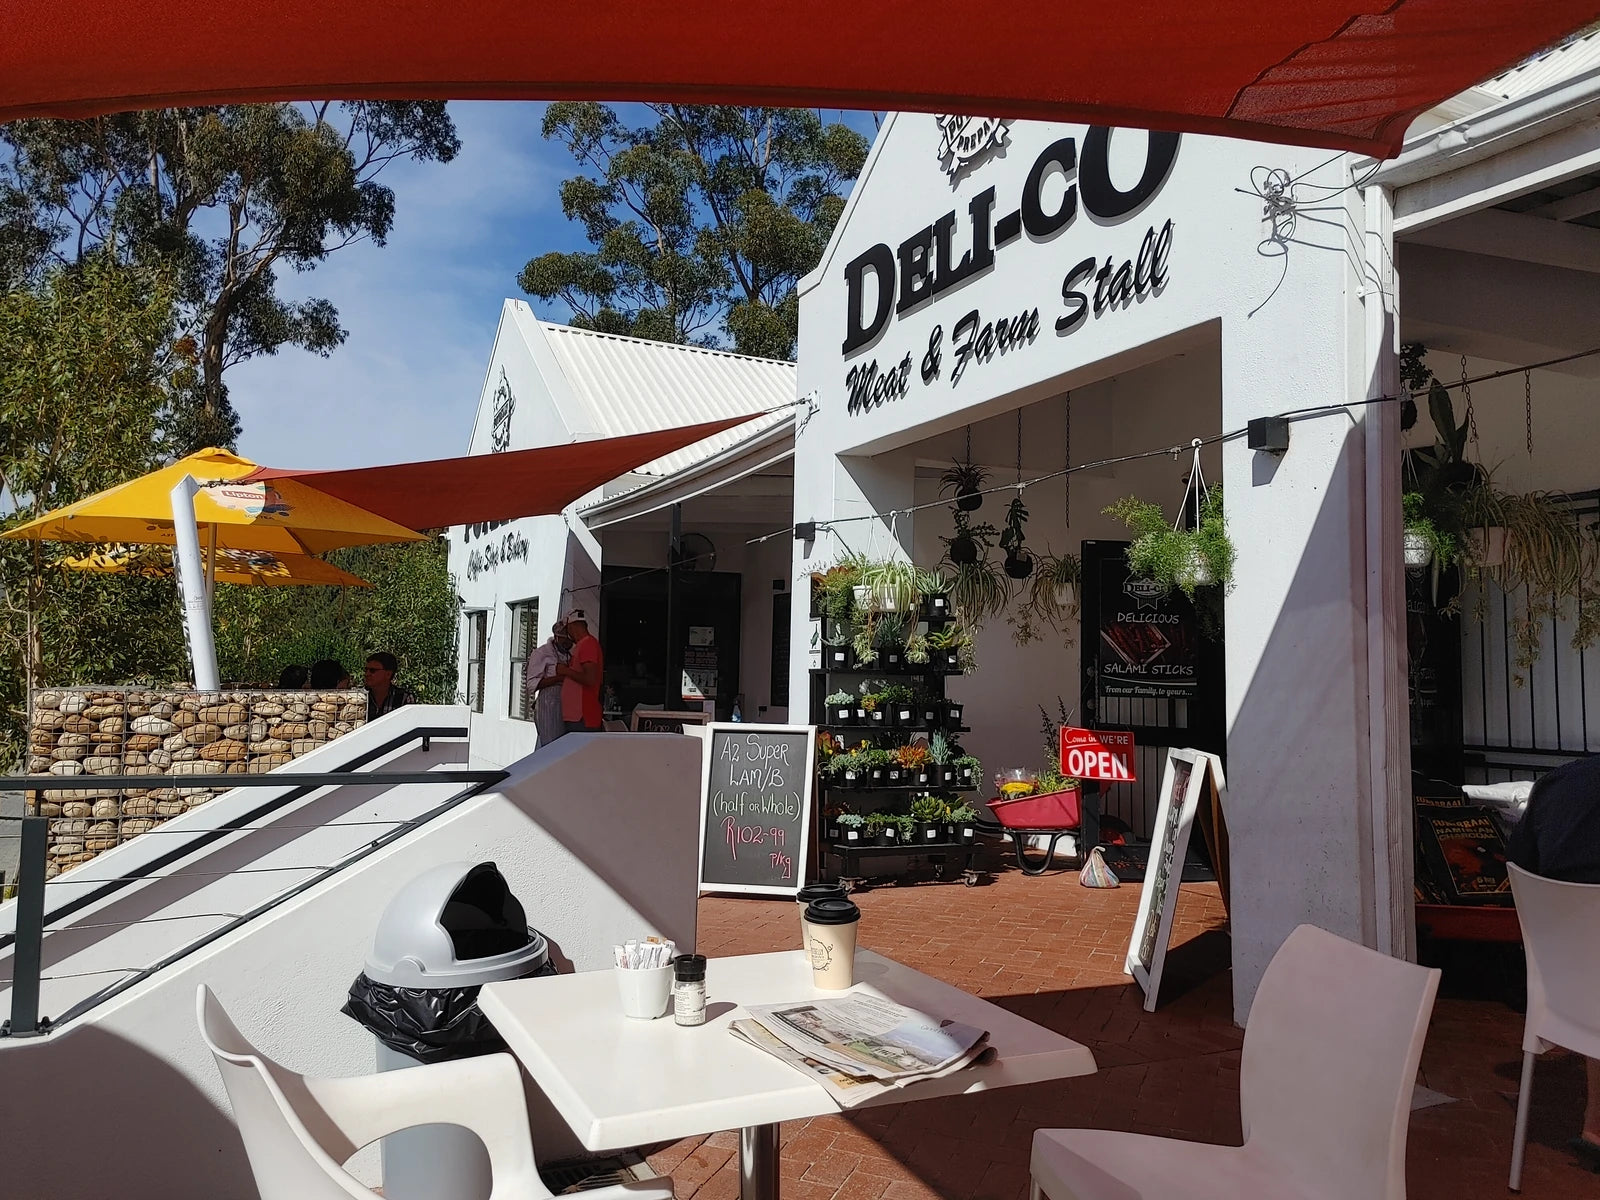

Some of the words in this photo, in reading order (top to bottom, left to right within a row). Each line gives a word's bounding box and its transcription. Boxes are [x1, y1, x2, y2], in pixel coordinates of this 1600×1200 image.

[957, 117, 994, 152] PREPA
[842, 124, 1181, 356] DELI-CO
[846, 351, 911, 413] Meat
[921, 325, 943, 381] &
[950, 306, 1039, 383] Farm
[1055, 218, 1172, 331] Stall
[225, 491, 263, 500] Lipton
[1117, 612, 1180, 625] DELICIOUS
[1103, 662, 1148, 675] SALAMI
[1151, 664, 1194, 676] STICKS
[1105, 685, 1122, 694] From
[720, 736, 740, 762] A2
[1064, 729, 1087, 744] Come
[1088, 733, 1097, 743] in
[1099, 735, 1129, 745] WE'RE
[1068, 748, 1129, 779] OPEN
[713, 790, 749, 817] (half
[720, 815, 786, 861] R102-99
